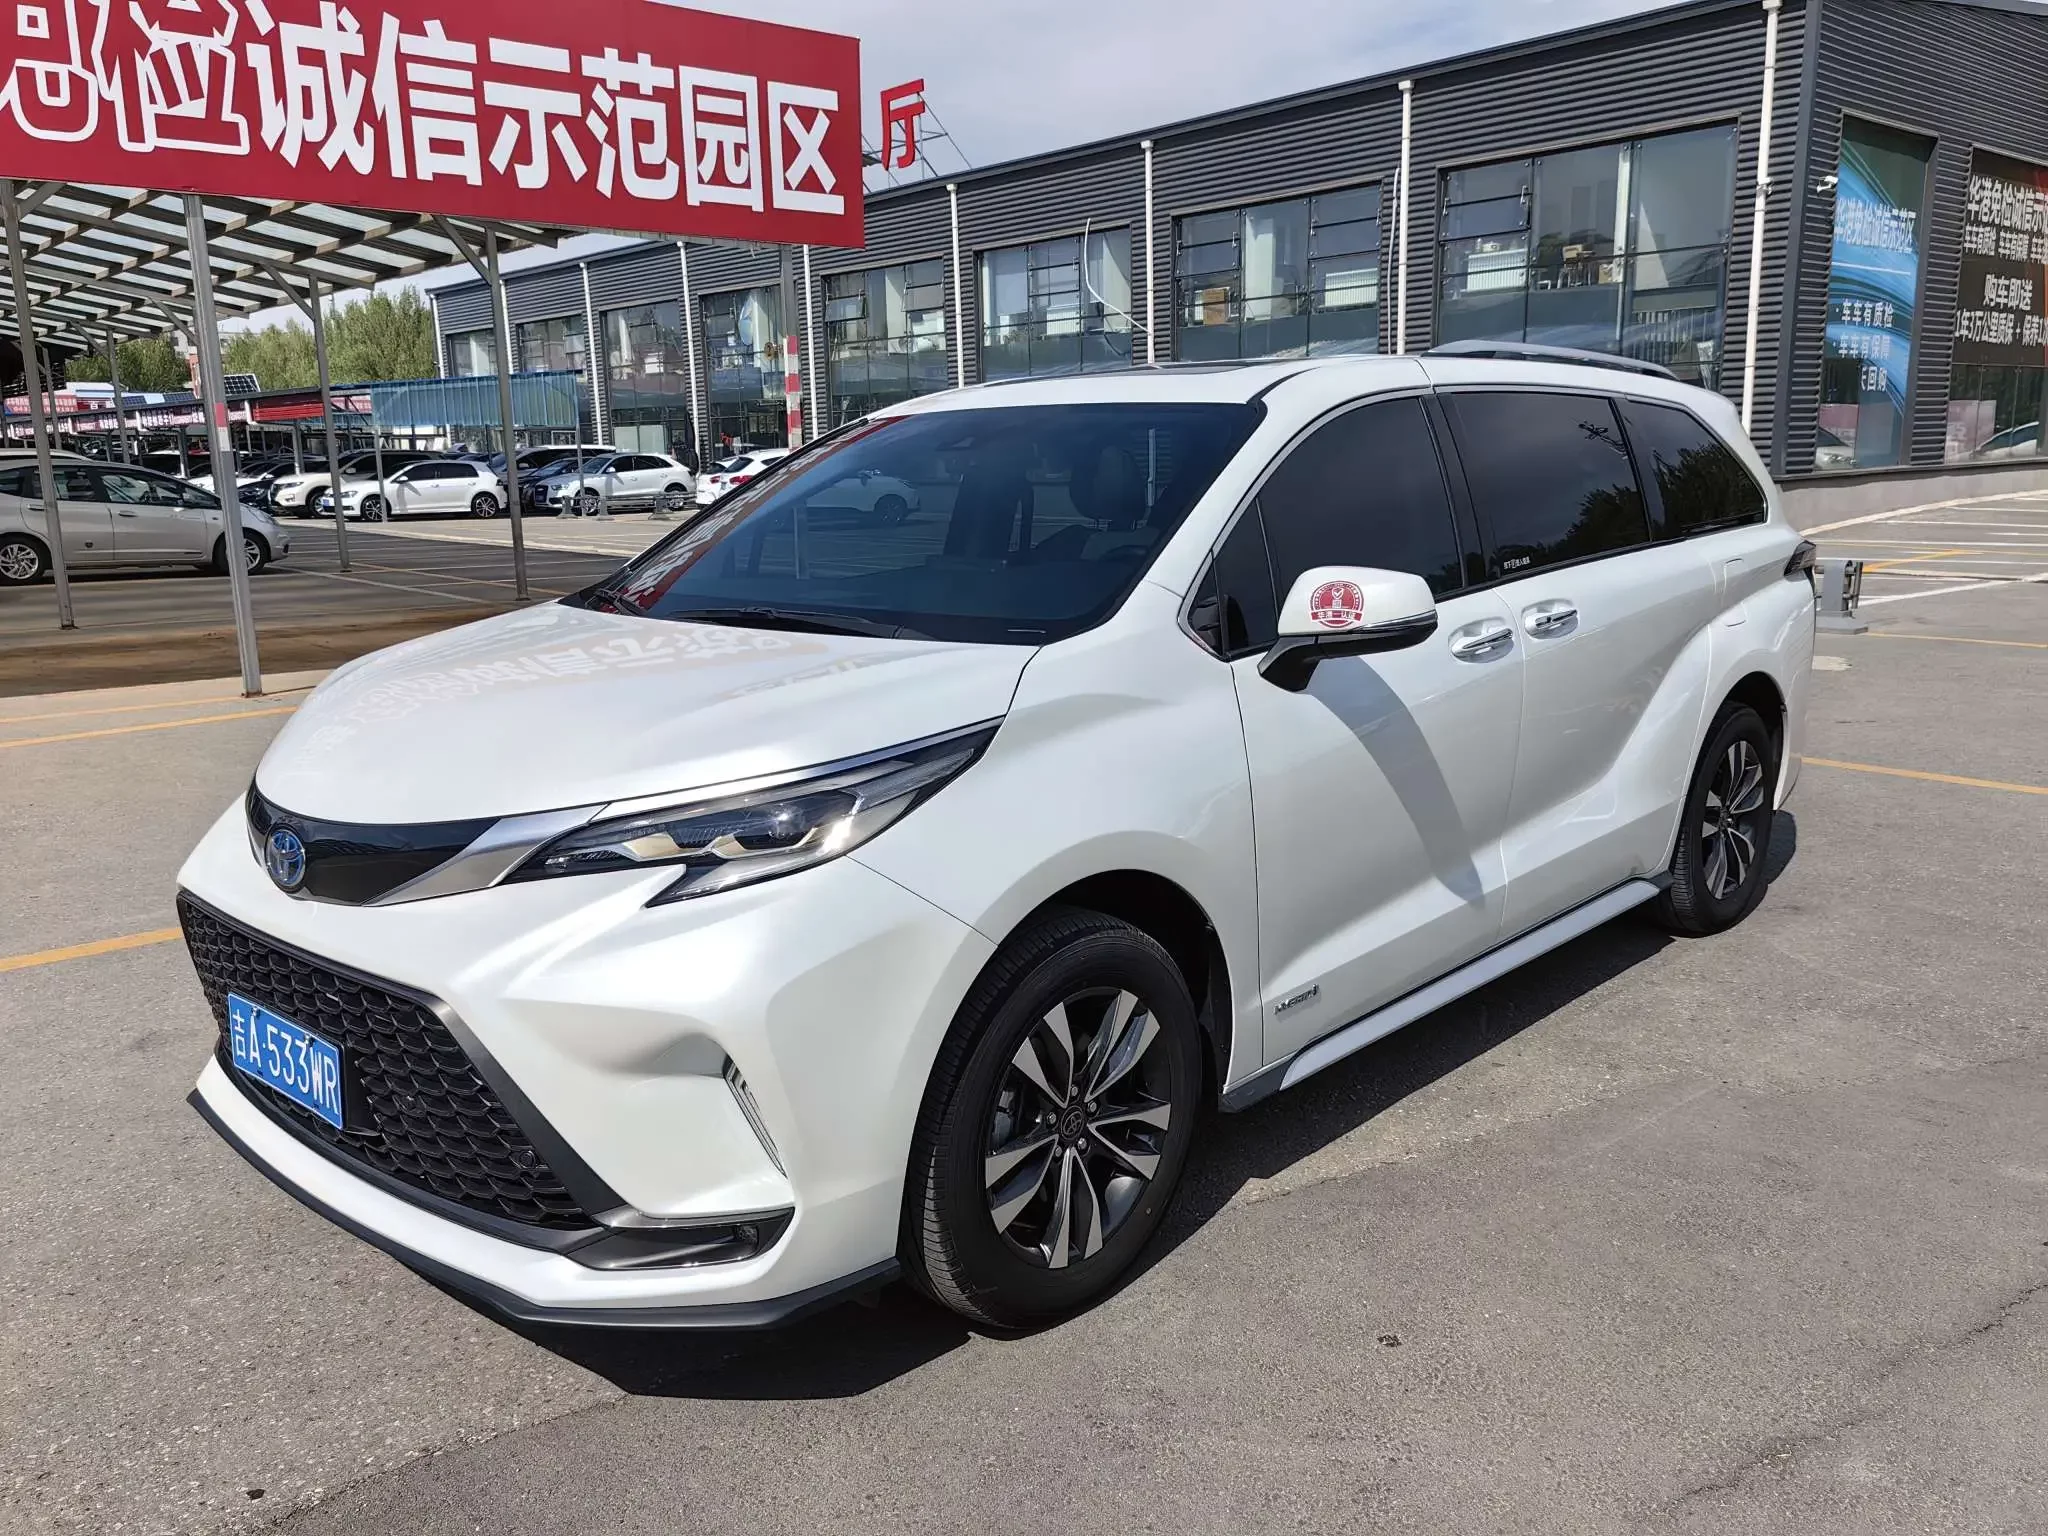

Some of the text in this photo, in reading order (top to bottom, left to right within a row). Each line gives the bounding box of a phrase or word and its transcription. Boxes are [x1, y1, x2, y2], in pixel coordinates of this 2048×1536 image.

[880, 78, 926, 171] 厅
[1983, 273, 2033, 311] 购车即送
[1841, 298, 1894, 328] 车车有质检
